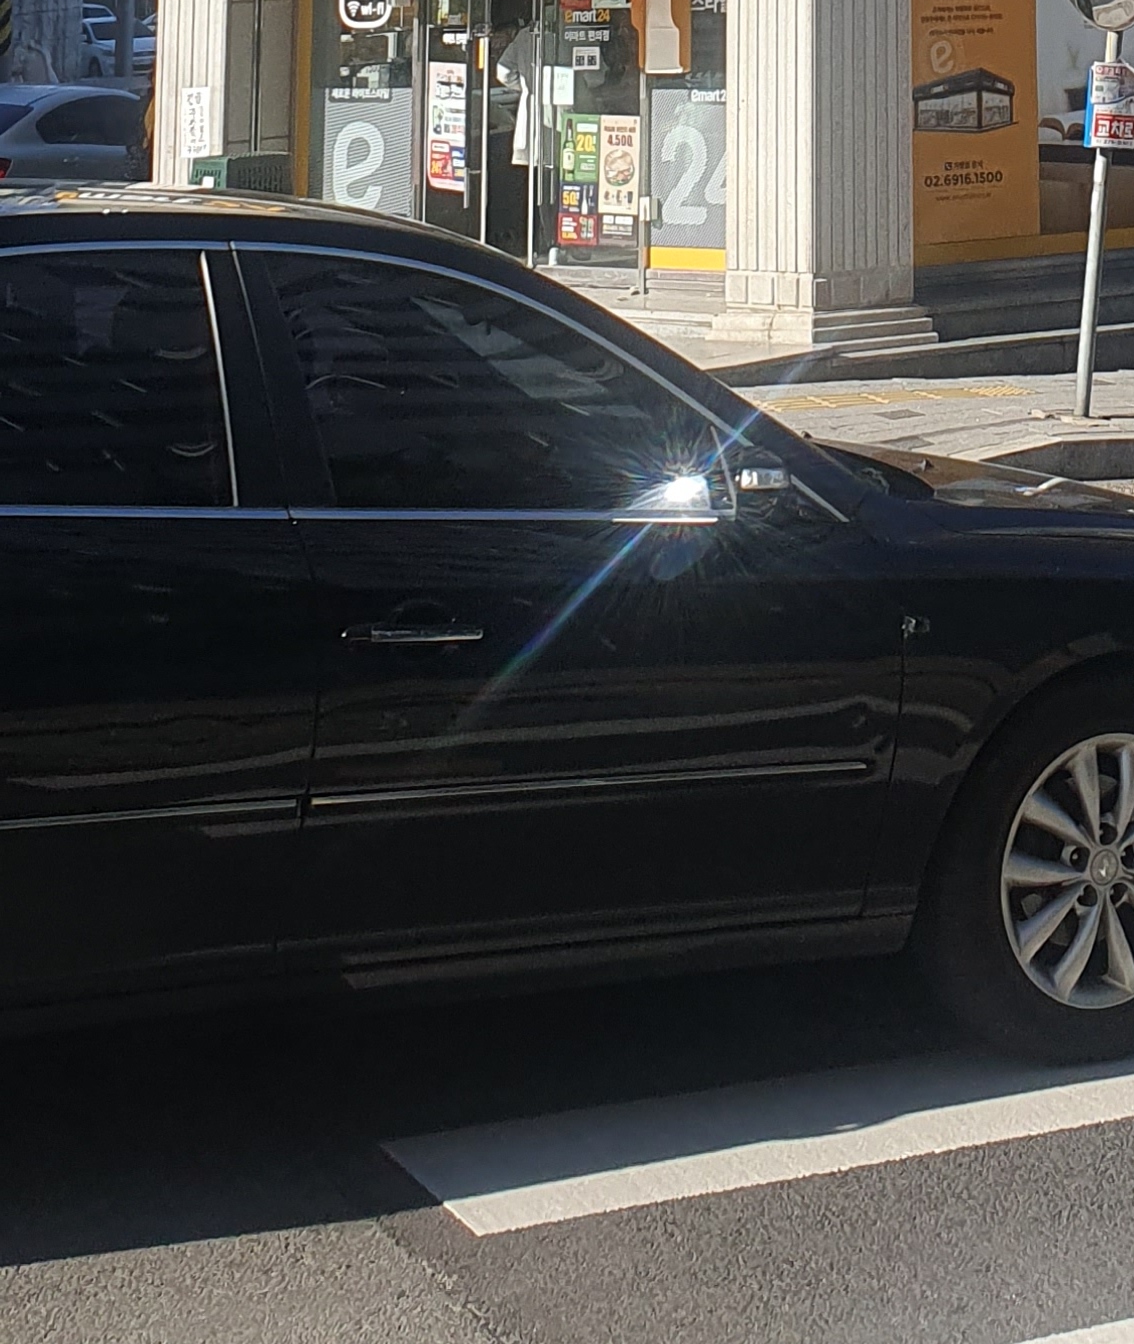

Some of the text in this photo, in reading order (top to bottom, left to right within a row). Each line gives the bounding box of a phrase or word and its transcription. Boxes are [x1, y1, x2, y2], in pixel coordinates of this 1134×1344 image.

[564, 8, 611, 24] emart24
[691, 89, 727, 103] emart2
[1095, 119, 1134, 139] 교차로
[333, 120, 386, 210] e
[923, 170, 1004, 188] 02.6916.1500
